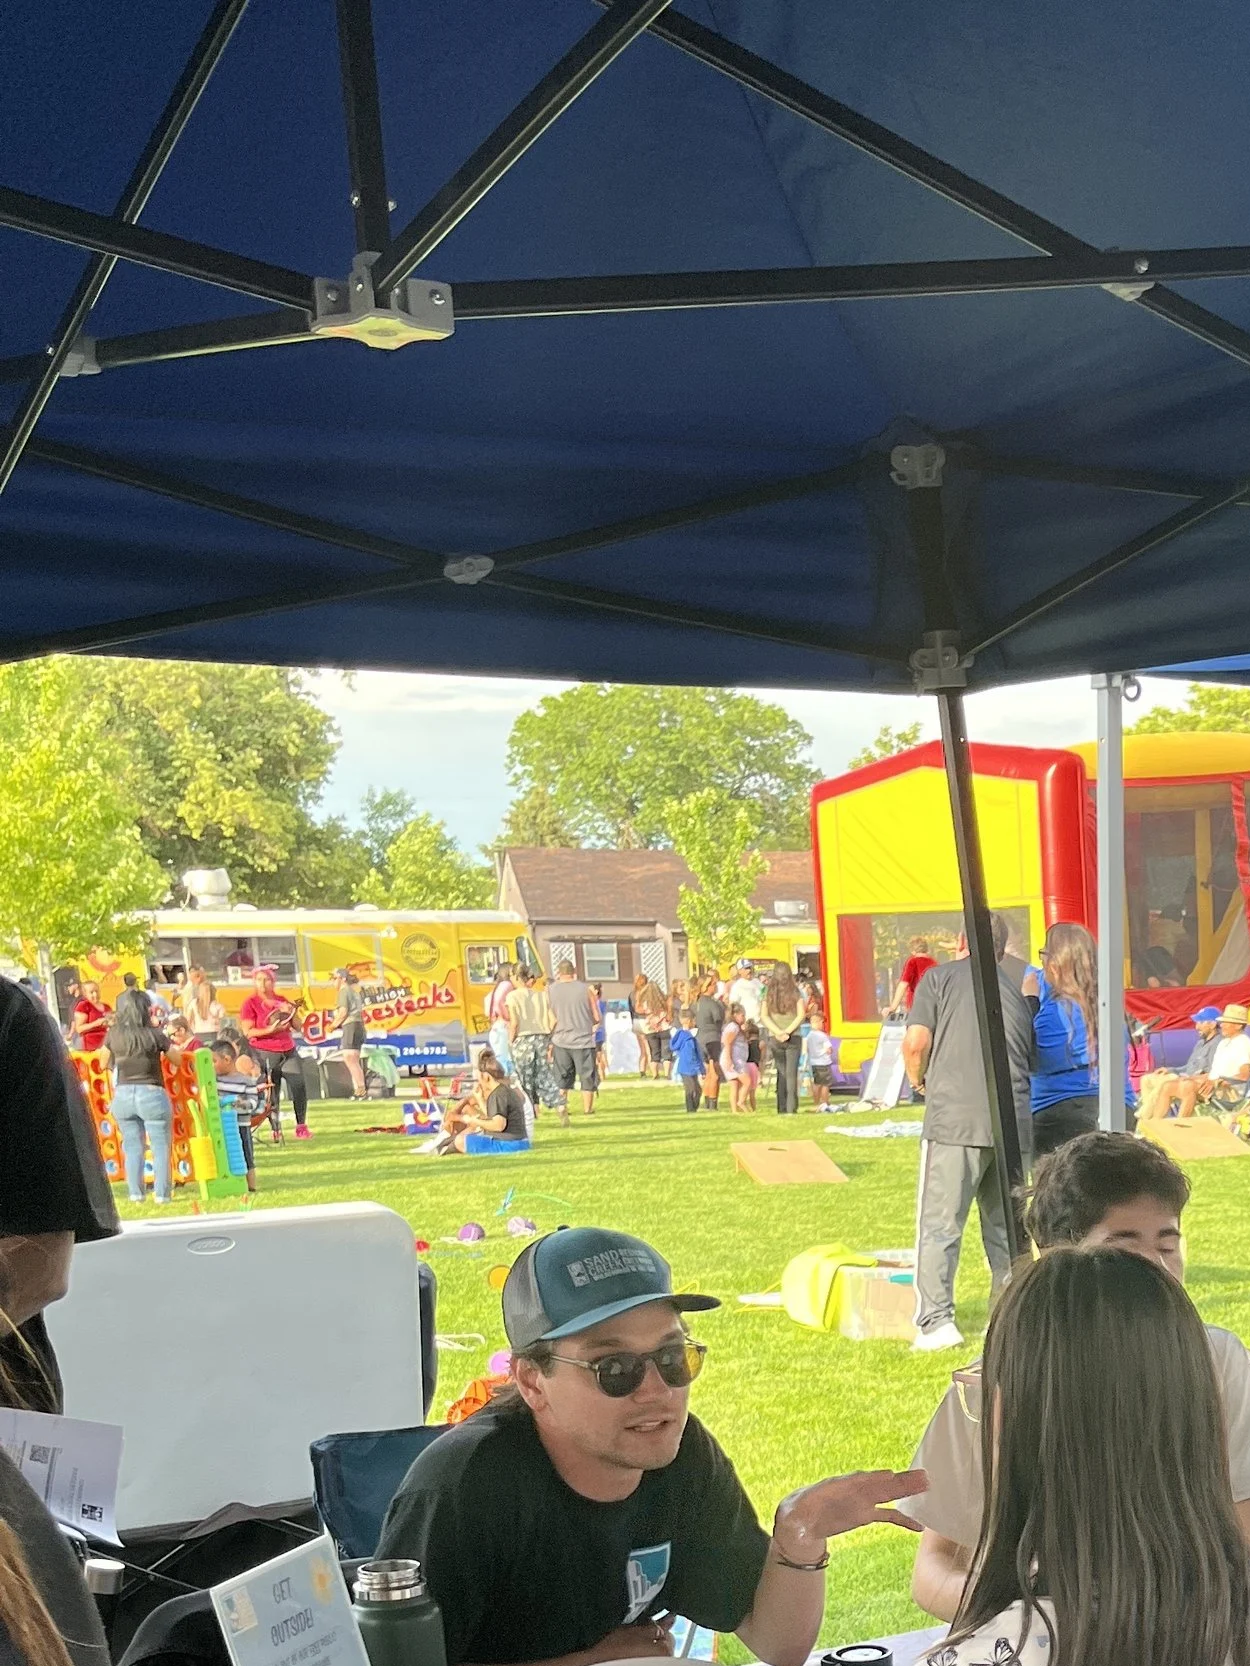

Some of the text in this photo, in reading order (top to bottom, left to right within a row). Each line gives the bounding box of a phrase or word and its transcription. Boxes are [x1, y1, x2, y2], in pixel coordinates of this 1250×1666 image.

[303, 983, 456, 1044] Chsesteaks
[583, 1249, 620, 1269] SAND
[272, 1577, 293, 1604] GET
[270, 1608, 315, 1647] OUTSIDE!
